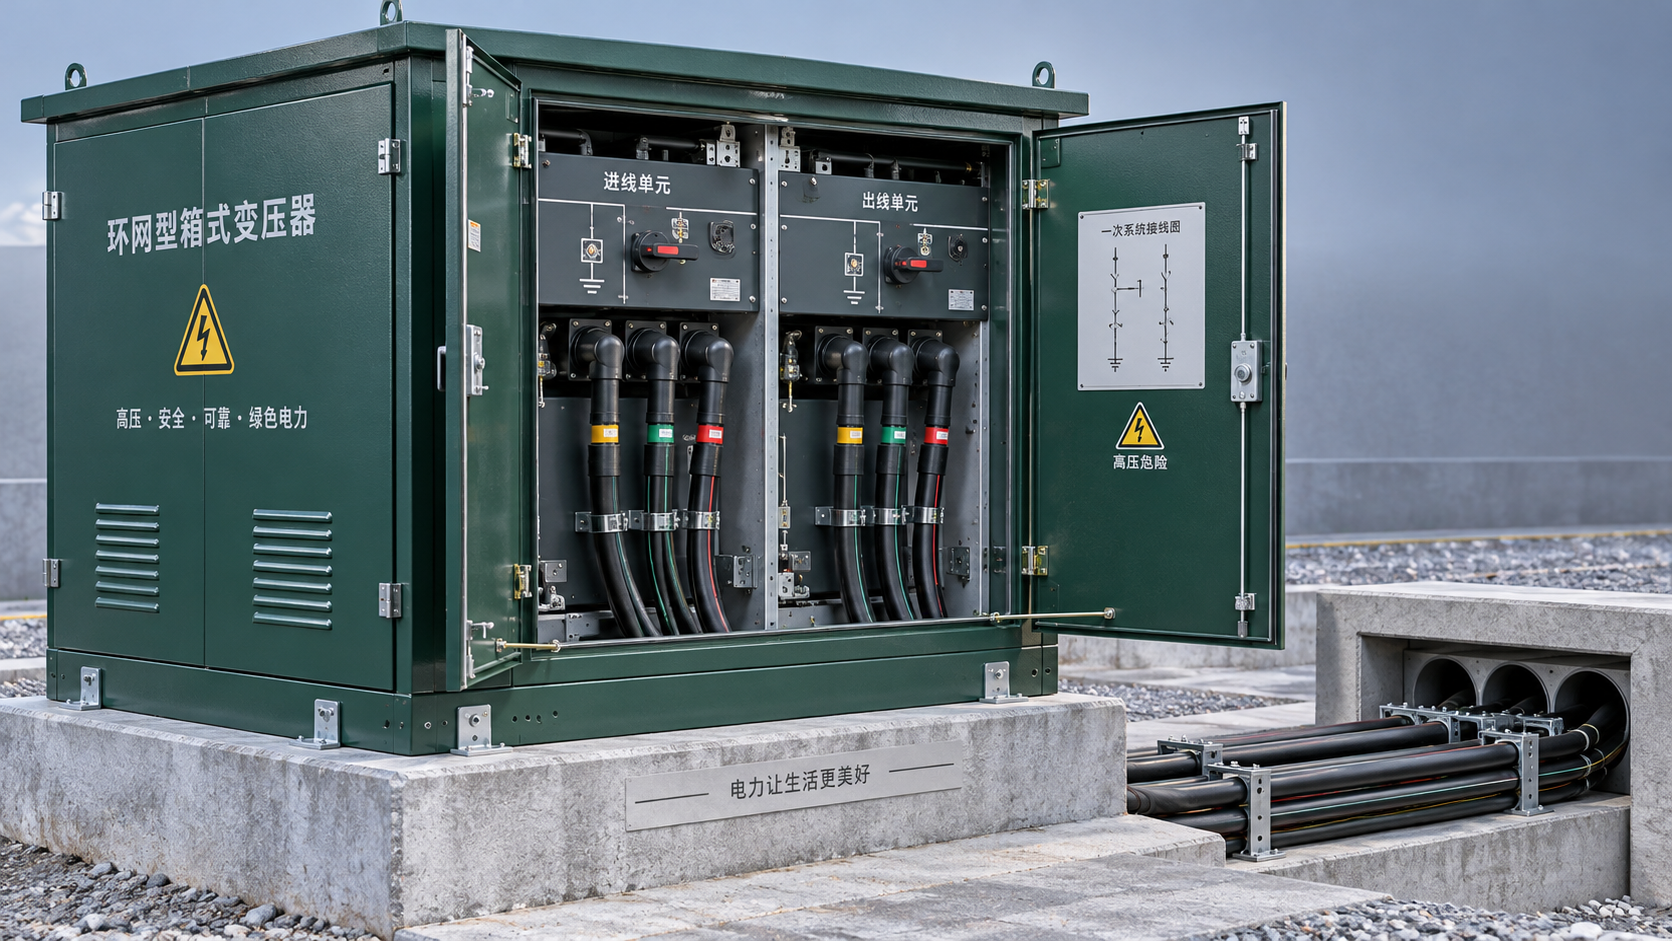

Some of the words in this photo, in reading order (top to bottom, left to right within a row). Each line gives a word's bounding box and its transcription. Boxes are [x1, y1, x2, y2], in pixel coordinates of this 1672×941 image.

[603, 171, 671, 195] 进线单元
[862, 191, 918, 212] 出线单元
[107, 193, 316, 256] 环网型箱式变压器
[1113, 453, 1168, 470] 高压危险
[731, 764, 870, 800] 电力让生活更美好
